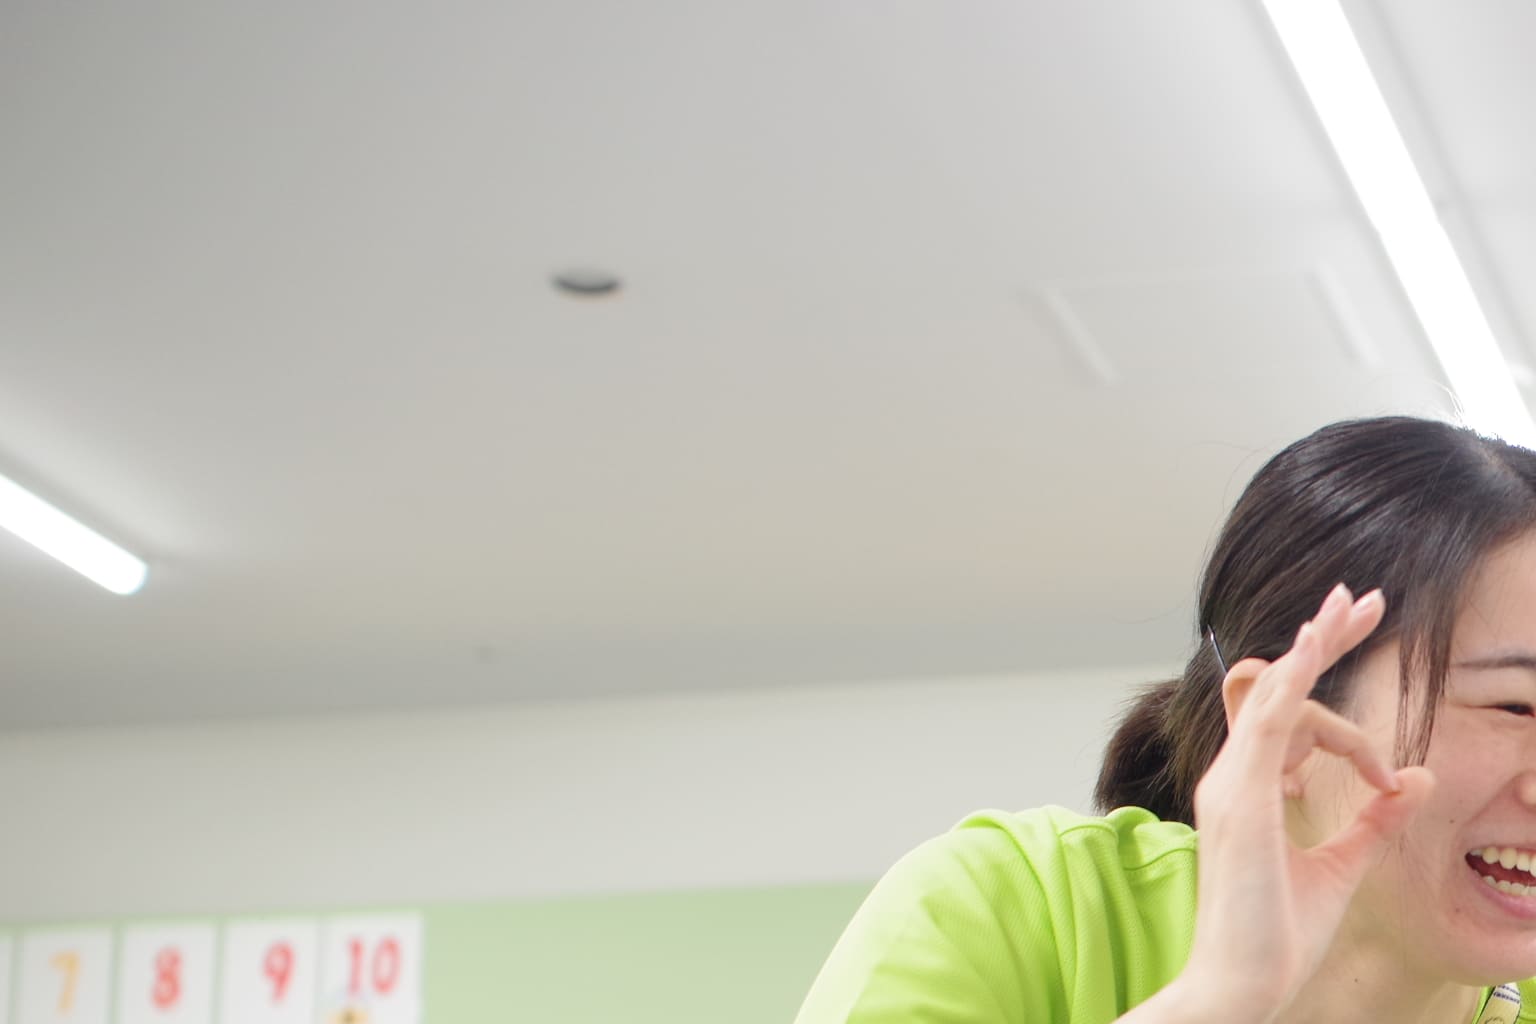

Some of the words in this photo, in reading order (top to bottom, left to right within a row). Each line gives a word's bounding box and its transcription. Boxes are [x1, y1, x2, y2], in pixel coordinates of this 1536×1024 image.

[48, 949, 82, 1018] 7
[151, 944, 184, 1011] 8
[262, 940, 296, 1004] 9
[346, 934, 403, 997] 10
